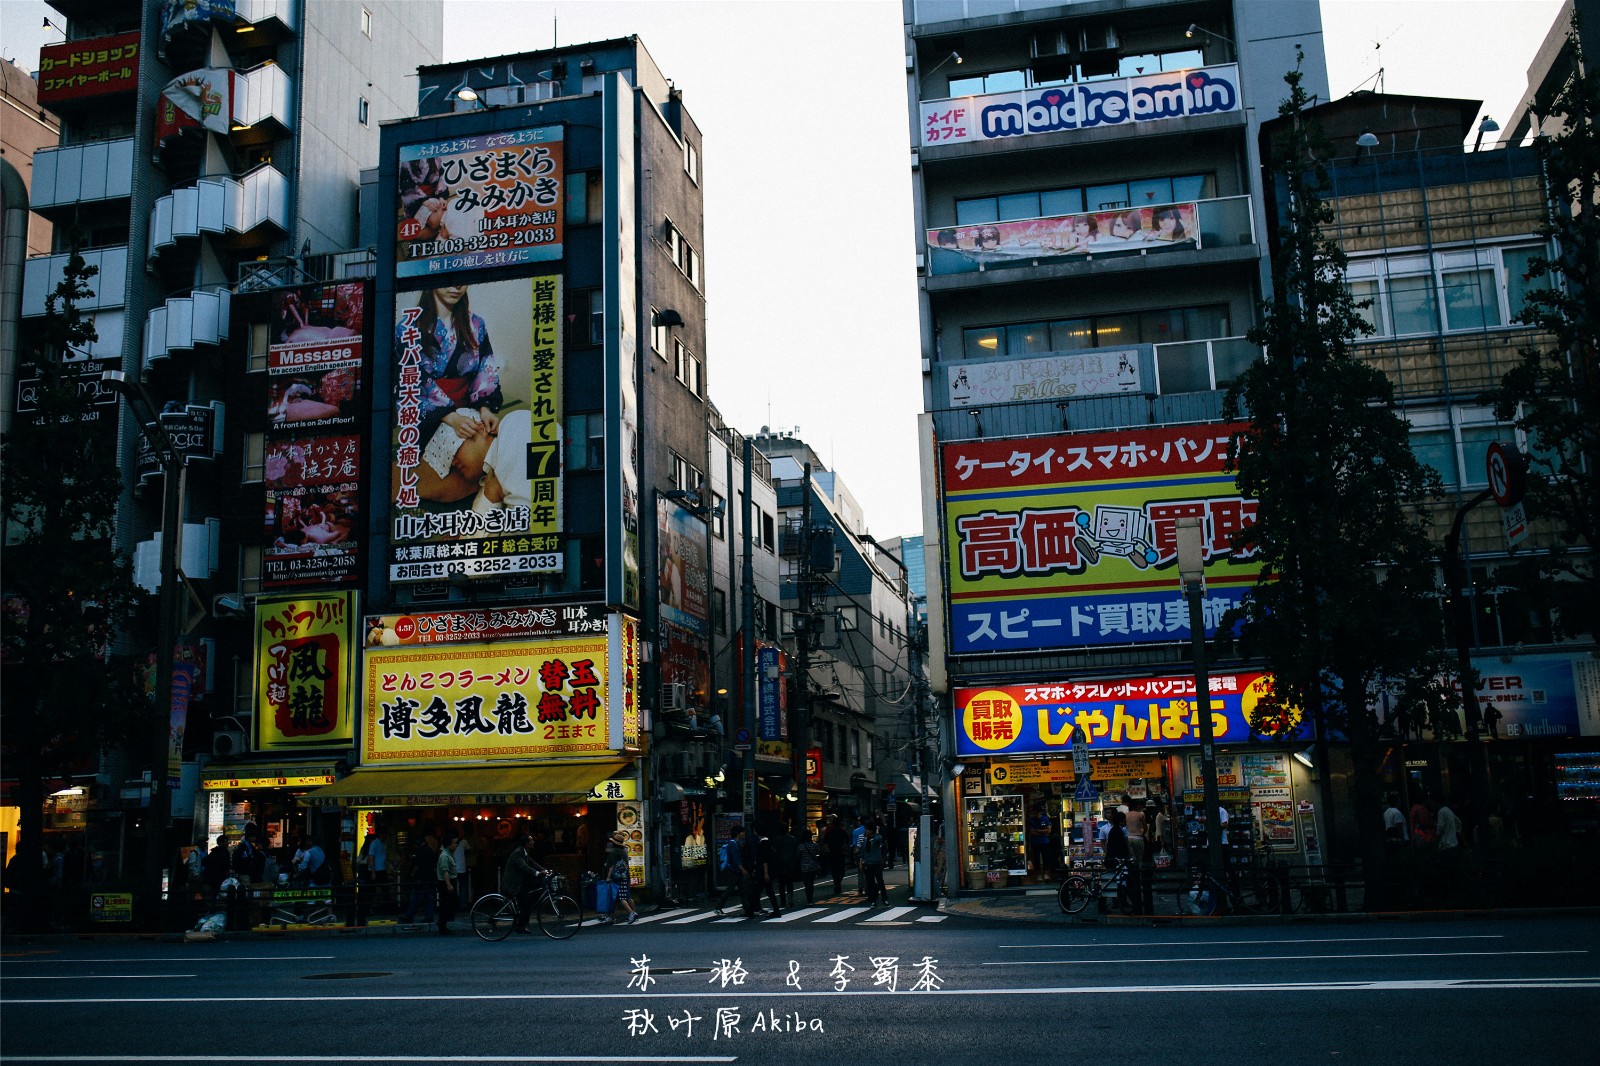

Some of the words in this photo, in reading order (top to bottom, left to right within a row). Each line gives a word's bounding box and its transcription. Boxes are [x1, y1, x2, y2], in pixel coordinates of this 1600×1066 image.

[41, 43, 137, 71] カードショップ
[44, 67, 132, 91] ファイヤーボール
[926, 108, 965, 125] メイド
[984, 74, 1236, 137] maidreamin
[418, 139, 476, 156] ふれるように
[486, 129, 544, 148] なでるように
[926, 125, 967, 142] カフェ
[442, 147, 553, 185] ひざまくら
[455, 178, 557, 213] みみかき
[400, 223, 420, 238] 4F
[479, 210, 556, 232] 山本耳かき店
[428, 249, 529, 272] 極上の癒しを貴方に
[279, 347, 352, 365] Massage
[304, 362, 328, 372] English
[329, 360, 361, 369] speakers.
[1010, 378, 1077, 401] Filles
[398, 306, 423, 508] アキバ最大級の癒し処
[531, 280, 558, 528] 皆様に愛されて7周年
[280, 421, 299, 429] front
[318, 418, 331, 426] 2nd
[332, 416, 355, 425] Floor!
[268, 440, 356, 461] 山本耳かき店
[301, 456, 357, 480] 撫子庵
[395, 506, 530, 540] 山本耳かき店
[396, 542, 478, 561] 秋葉原総本店
[483, 541, 499, 555] 2F
[502, 536, 560, 554] 総合受付
[959, 508, 1084, 578] 高価
[266, 561, 286, 573] TEL
[290, 555, 356, 570] 03-3256-2058
[396, 562, 444, 579] お問合せ
[562, 606, 587, 621] 山本
[967, 597, 1255, 643] スピード買取実施
[396, 624, 414, 632] 4.5F
[417, 635, 432, 643] TEL
[435, 631, 480, 642] 03-3252-2033
[269, 645, 287, 703] つけ麺
[380, 666, 531, 692] とんこつラーメン
[539, 658, 600, 692] 替玉
[289, 642, 332, 730] 風龍
[378, 692, 535, 740] 博多風龍
[538, 687, 602, 724] 無料
[971, 699, 1012, 721] 買取
[543, 723, 597, 741] 2玉まで
[971, 721, 1014, 742] 販売
[1038, 698, 1228, 746] じゃんぱら
[1523, 718, 1568, 736] Marlboro
[963, 767, 982, 775] Mac
[995, 769, 1006, 779] 1F
[966, 781, 981, 790] 2F
